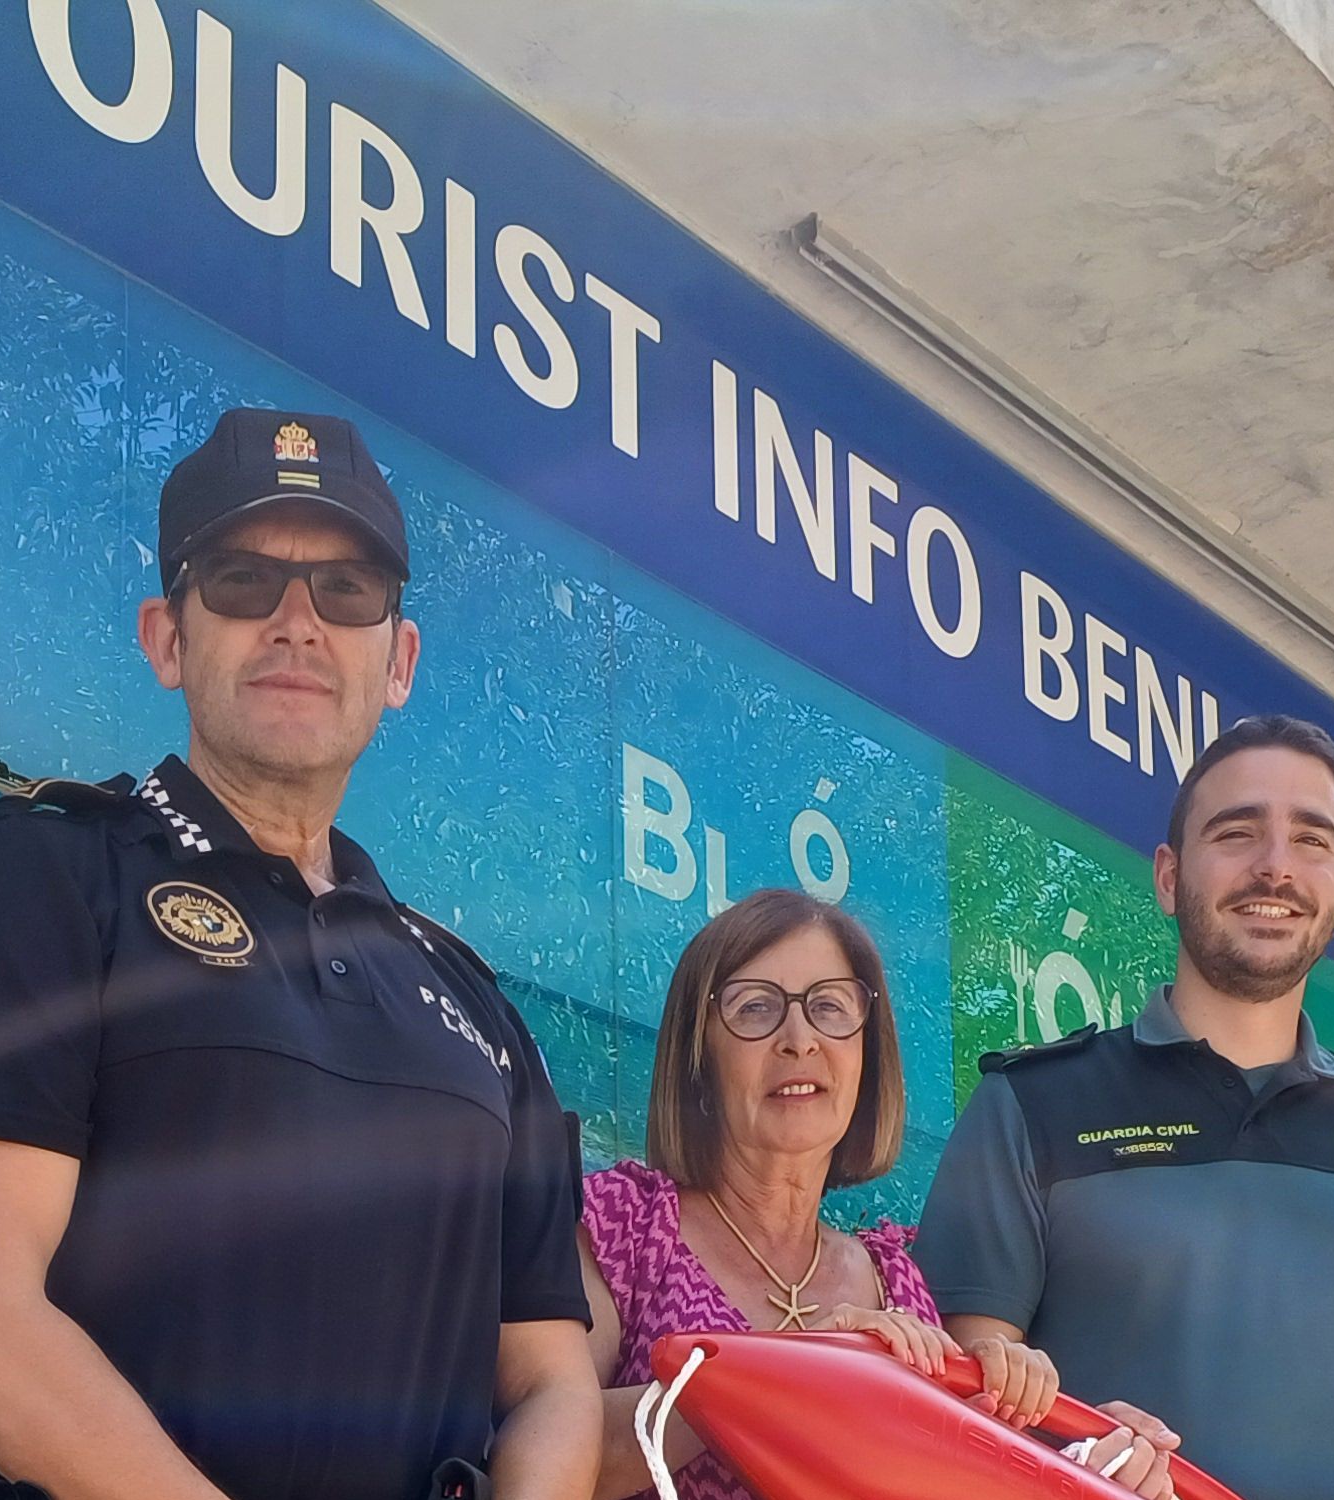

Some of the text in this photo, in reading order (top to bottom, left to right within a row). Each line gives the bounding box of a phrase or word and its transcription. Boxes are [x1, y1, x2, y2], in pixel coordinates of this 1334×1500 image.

[711, 358, 983, 659] INFO
[1077, 1123, 1200, 1144] GUARDIA CIVIL
